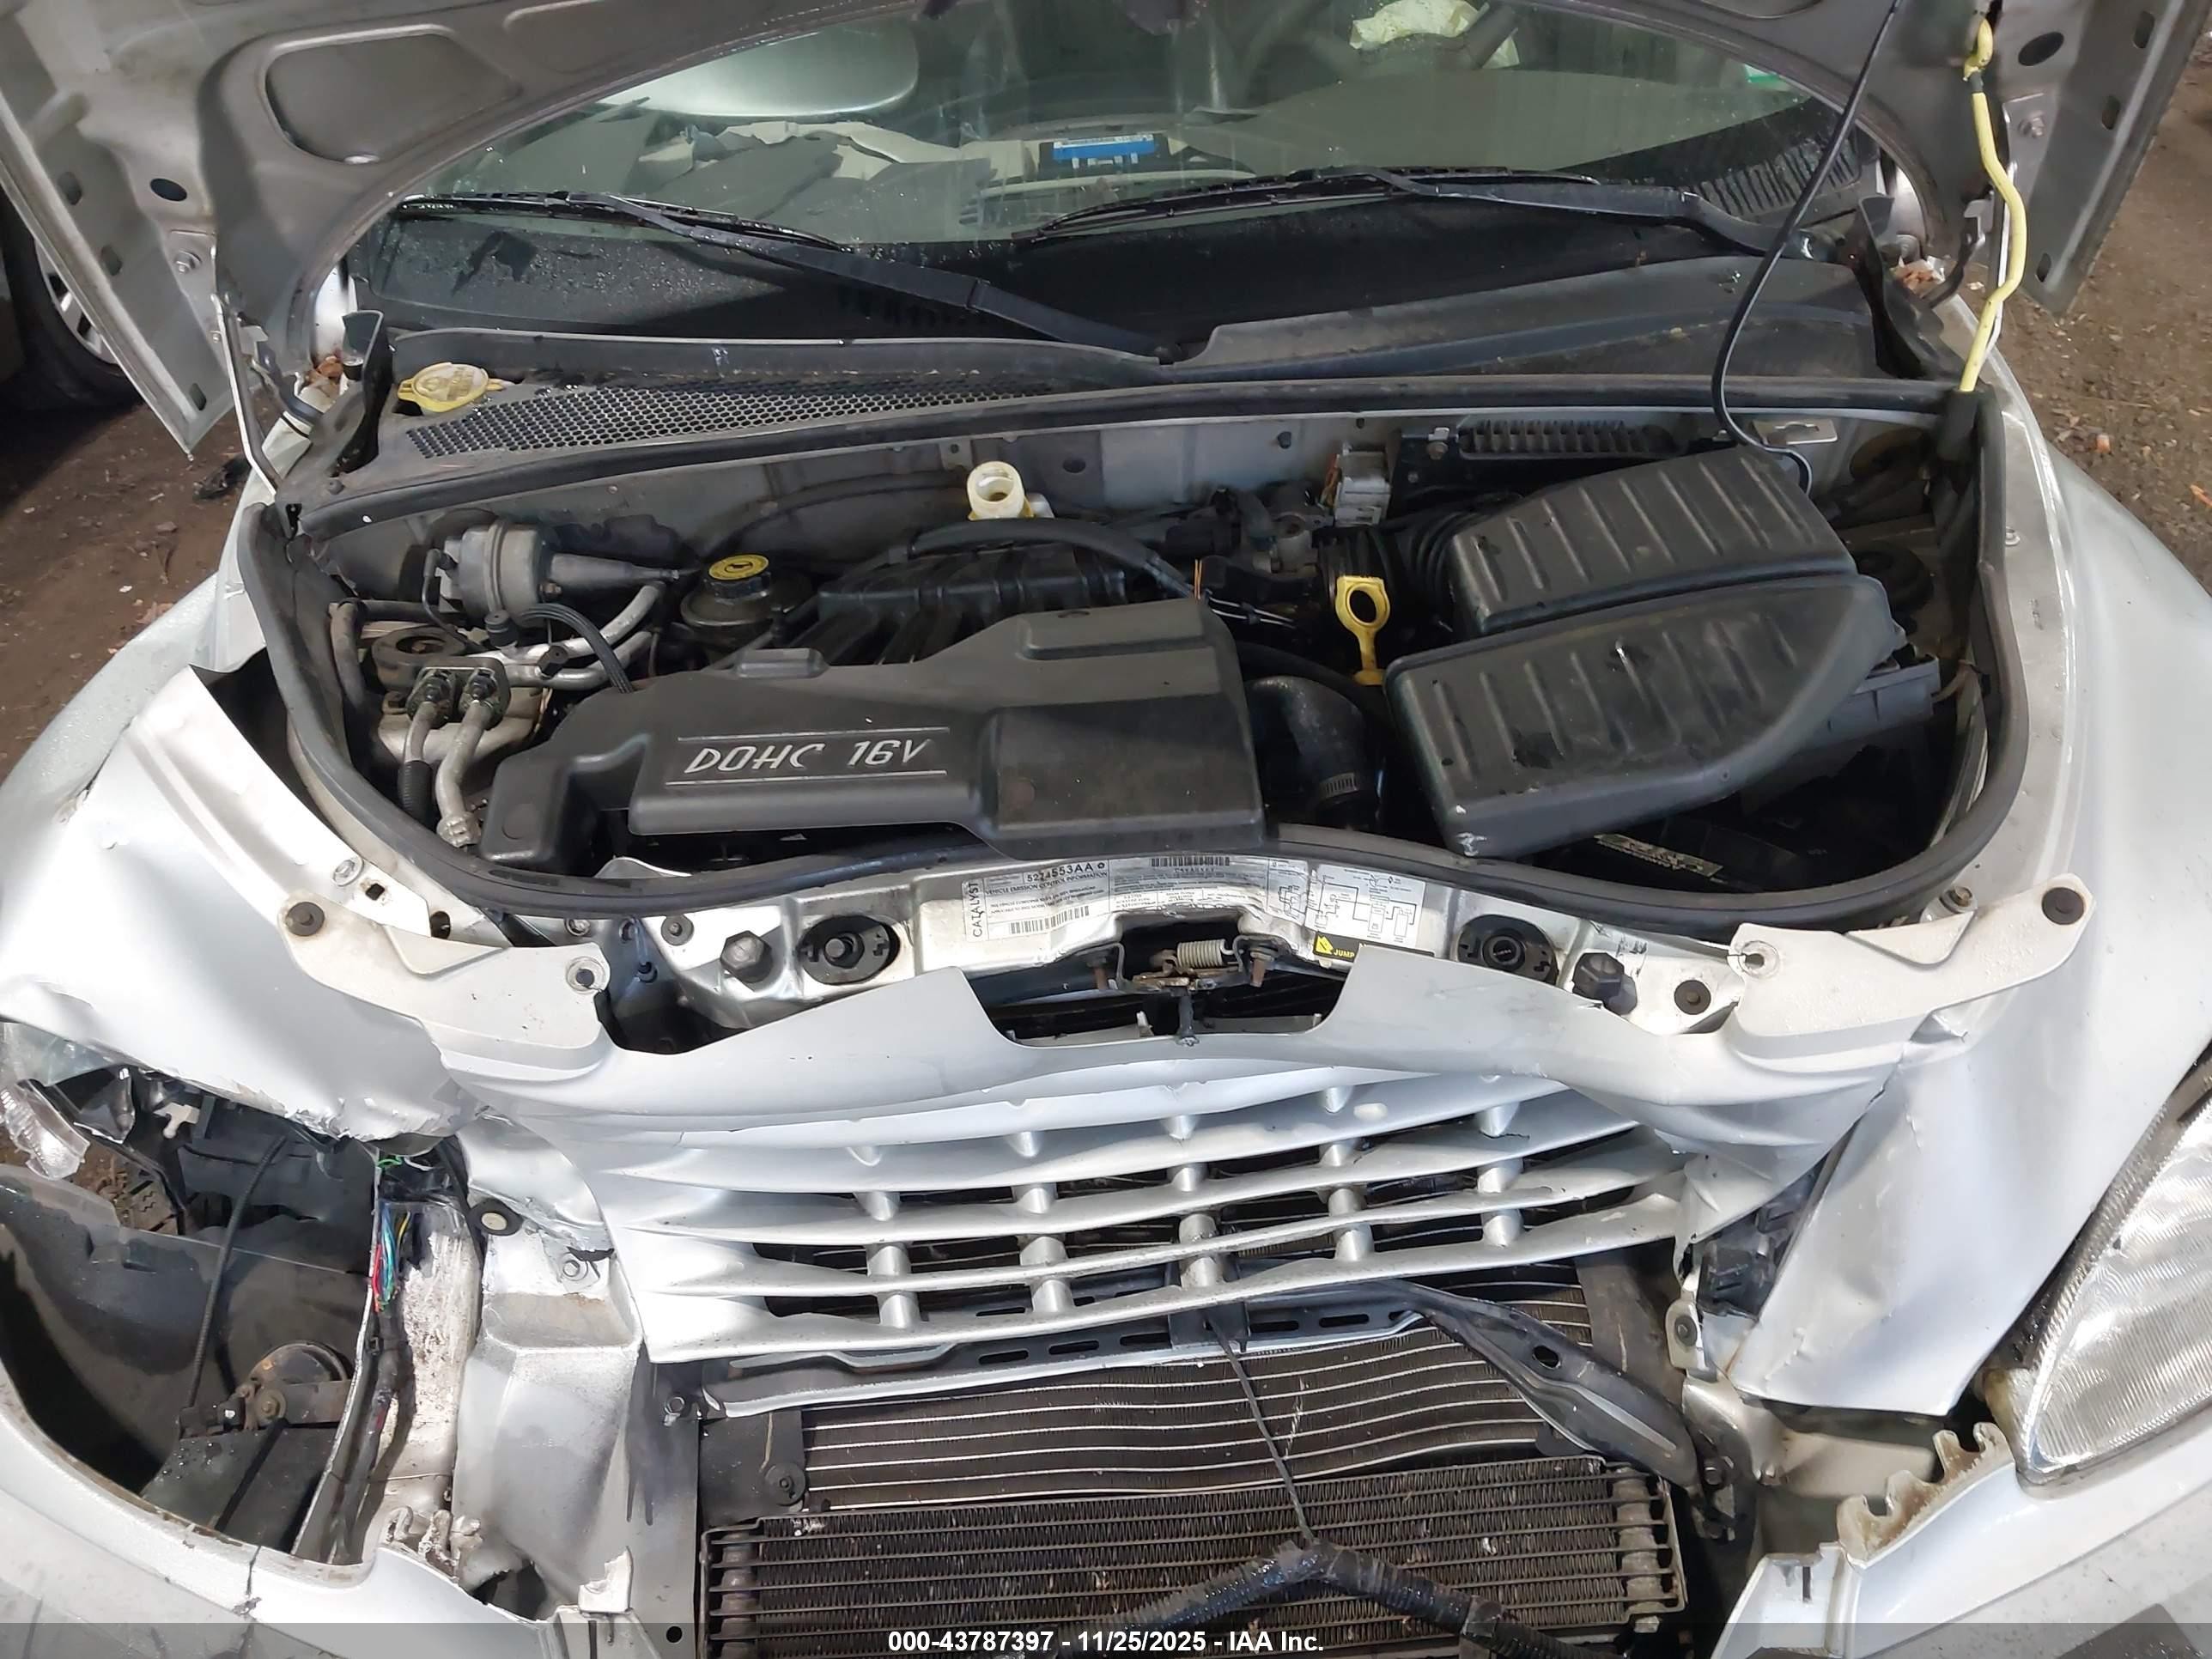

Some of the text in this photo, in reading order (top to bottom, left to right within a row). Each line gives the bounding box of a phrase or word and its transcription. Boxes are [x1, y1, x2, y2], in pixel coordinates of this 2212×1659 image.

[684, 738, 933, 774] DOHC 16V
[968, 883, 983, 938] CATALYST
[1333, 948, 1355, 958] JUMP
